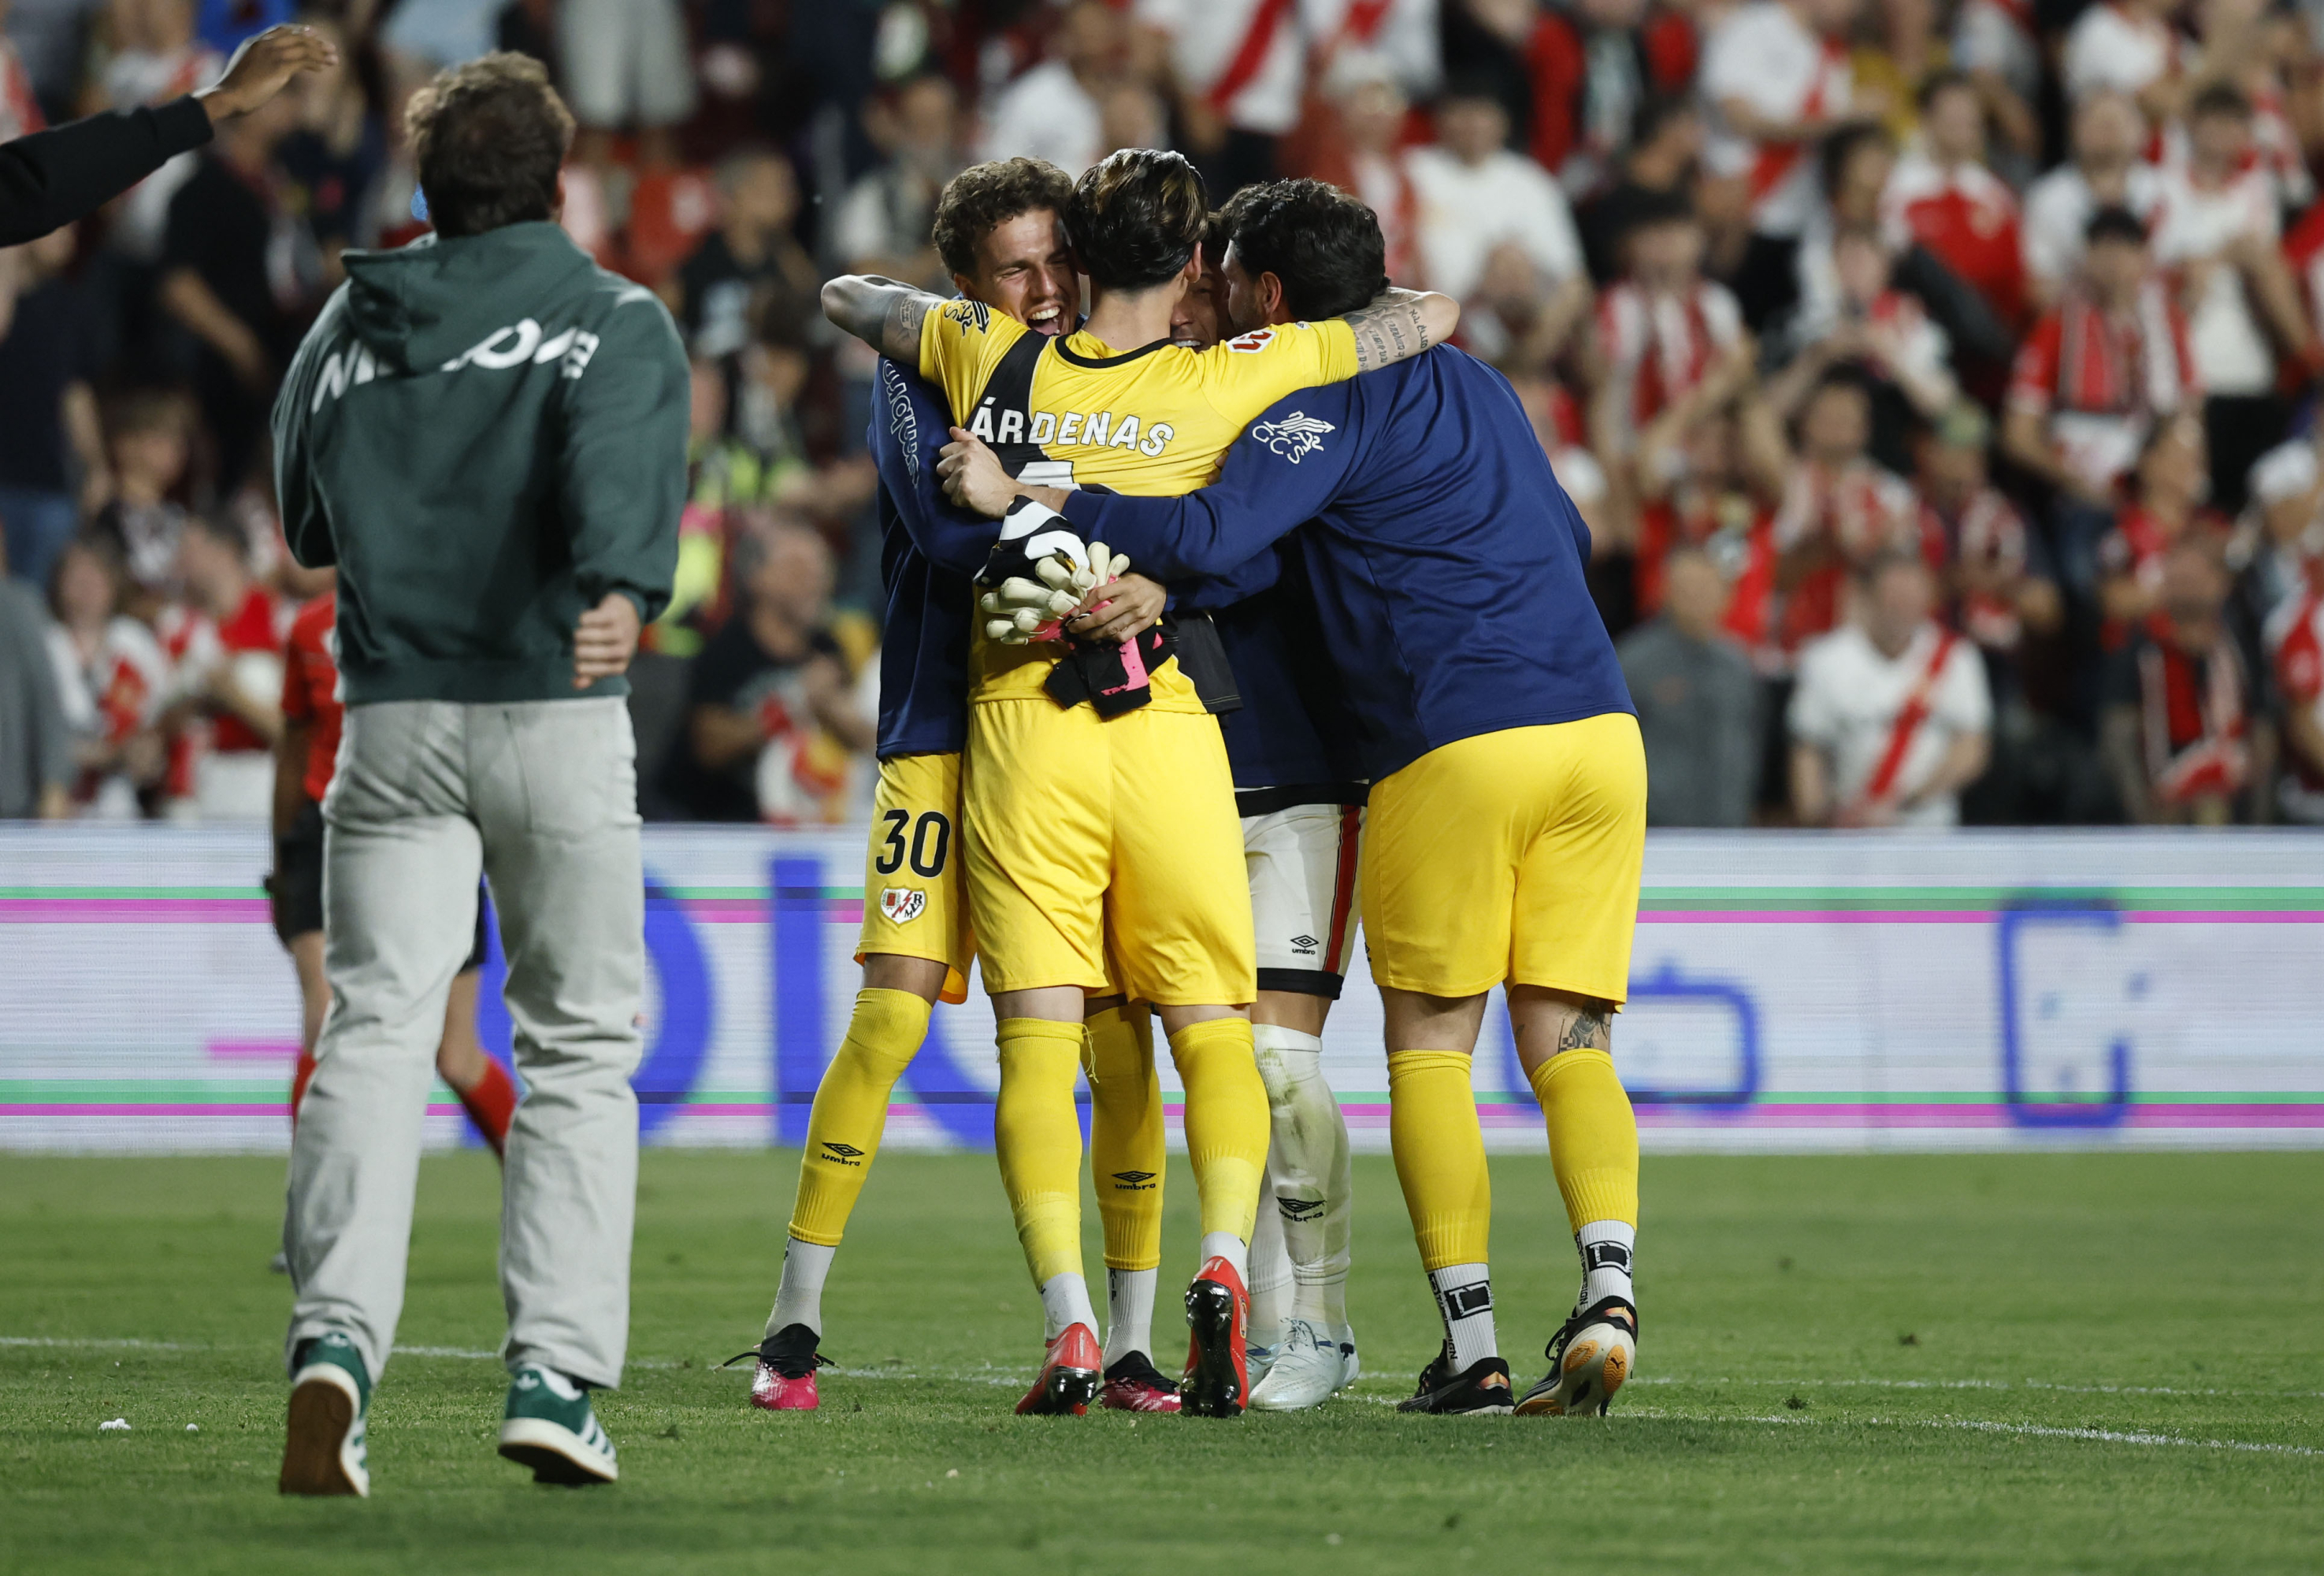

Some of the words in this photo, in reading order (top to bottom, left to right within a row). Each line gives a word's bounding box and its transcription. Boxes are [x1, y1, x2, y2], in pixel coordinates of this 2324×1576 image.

[882, 359, 920, 489] umbro
[961, 396, 1175, 458] ÁRDENAS
[875, 808, 952, 879] 30
[1292, 947, 1316, 956] umbro
[821, 1153, 861, 1167] umbro
[1115, 1182, 1156, 1191] umbro
[1279, 1207, 1324, 1222] umbro
